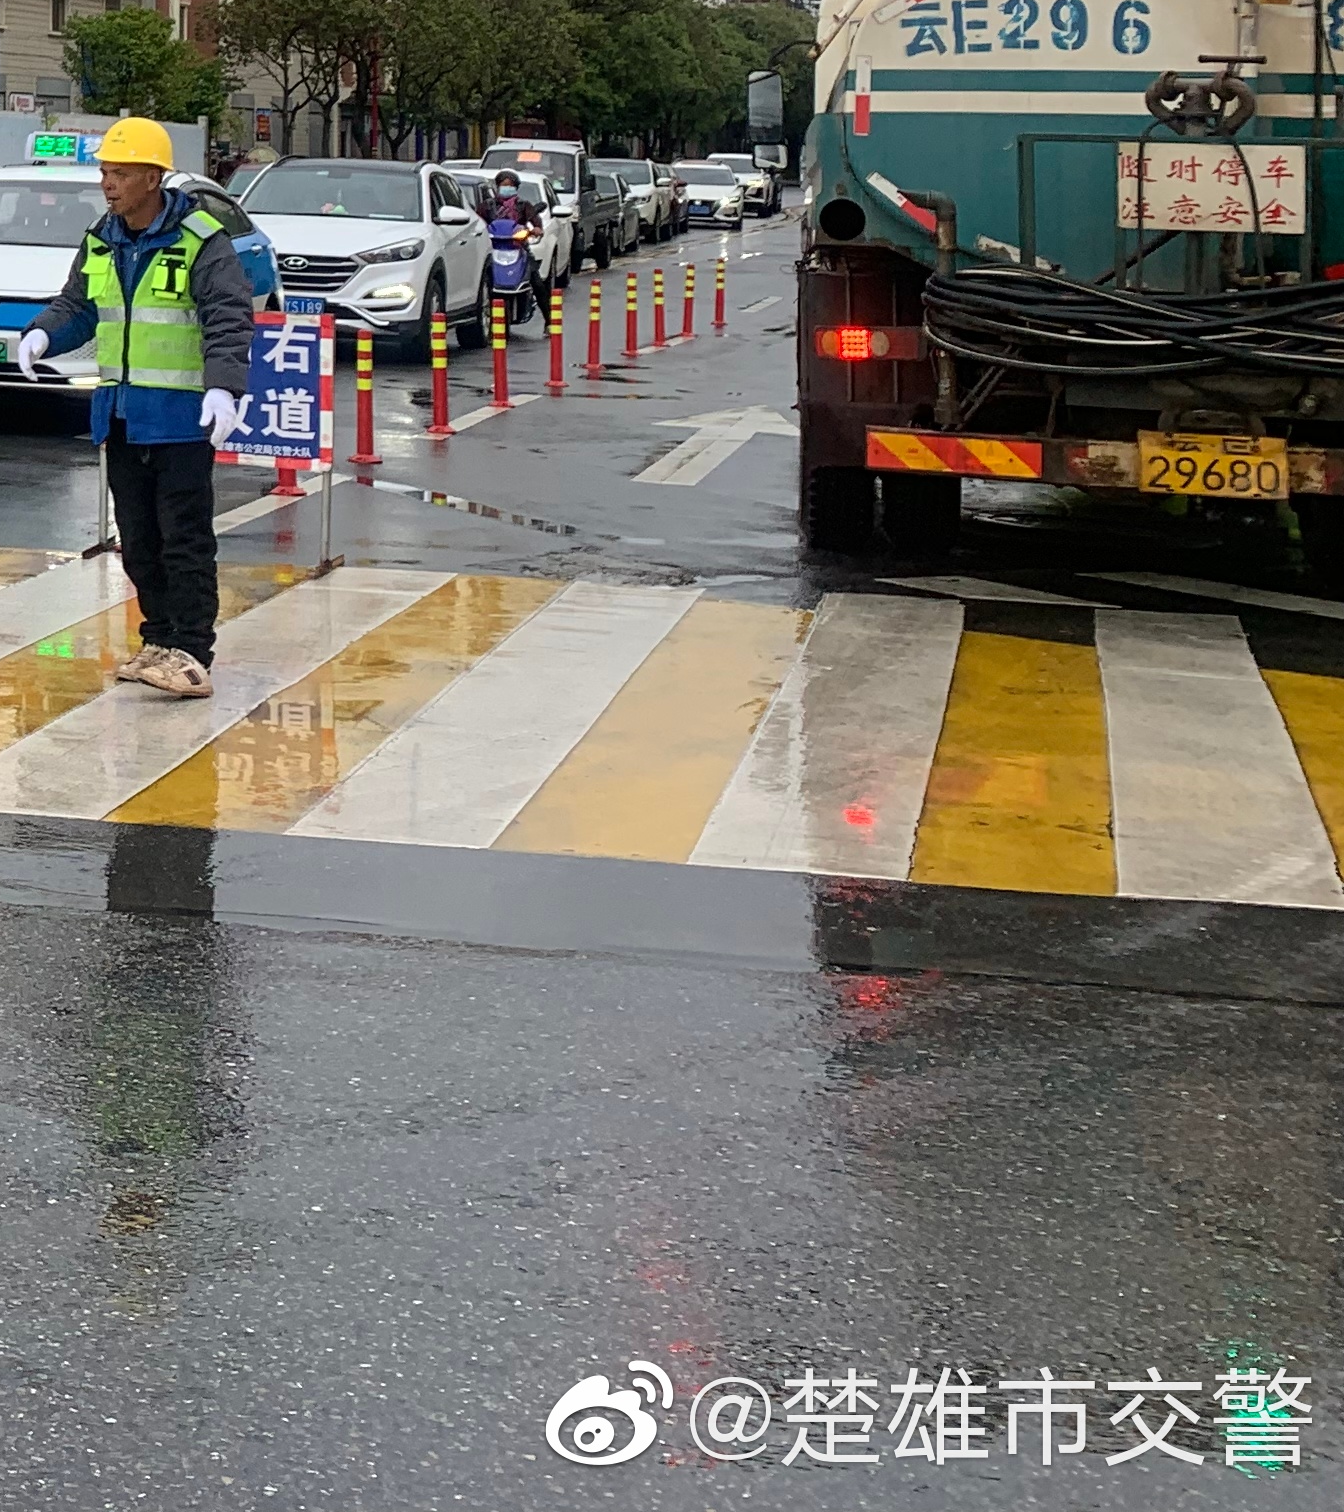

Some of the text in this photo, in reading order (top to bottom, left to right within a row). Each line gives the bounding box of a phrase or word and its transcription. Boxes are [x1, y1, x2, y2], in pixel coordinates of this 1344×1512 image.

[1120, 155, 1294, 188] 随时停车
[1121, 194, 1296, 225] 注意安全
[1147, 454, 1281, 494] 29680
